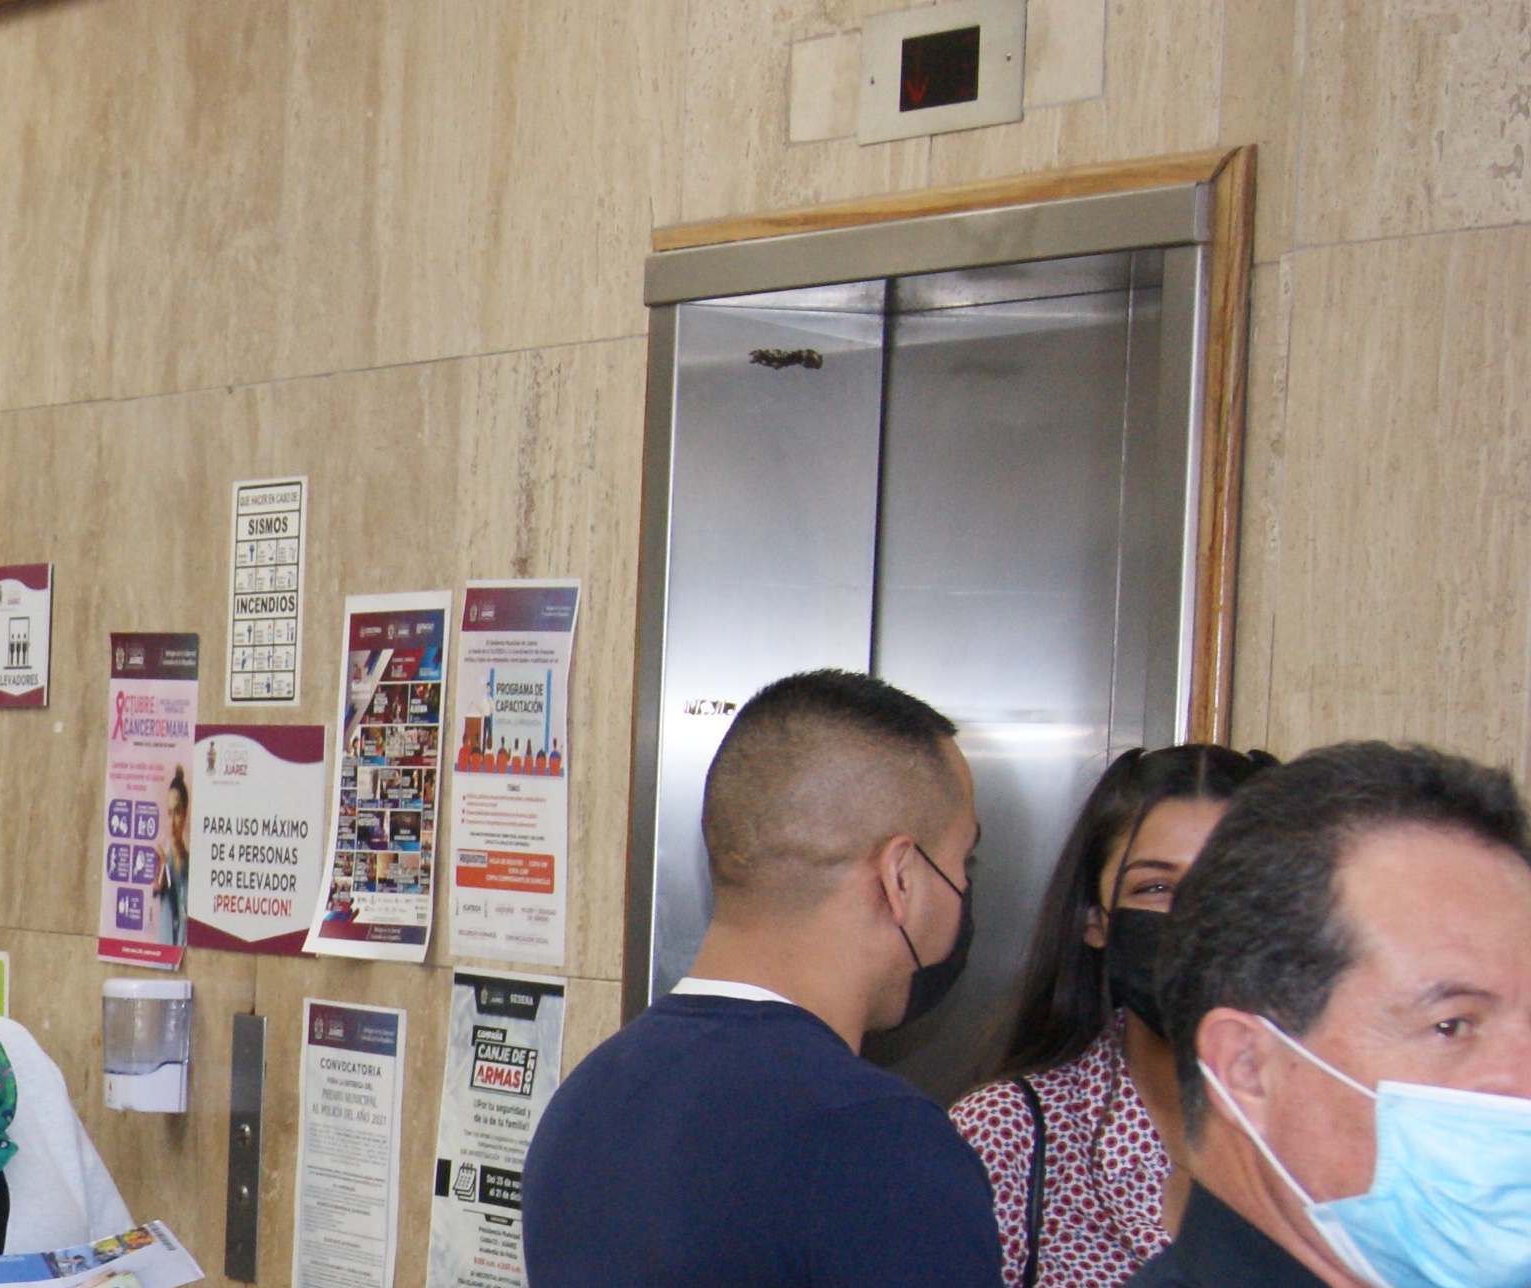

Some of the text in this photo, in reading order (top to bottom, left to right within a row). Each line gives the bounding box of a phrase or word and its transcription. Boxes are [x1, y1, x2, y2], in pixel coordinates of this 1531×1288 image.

[248, 516, 289, 536] SISMOS
[236, 595, 295, 615] INCENDIOS
[496, 682, 544, 696] PROGRAMA DE
[495, 697, 544, 713] CAPACITACIÓN
[203, 814, 309, 839] PARA USO MÁXIMO
[211, 843, 298, 866] DE 4 PERSONAS
[210, 869, 297, 892] POR ELEVADOR
[510, 993, 534, 1006] SEDENA
[477, 1043, 527, 1065] CANJE DE
[319, 1057, 382, 1078] CONVOCATORIA
[475, 1064, 523, 1089] ARMAS
[321, 1088, 377, 1108] PREMIO MUNICIPAL
[312, 1103, 320, 1115] AL
[343, 1107, 355, 1121] DEL
[355, 1108, 370, 1123] AÑO
[495, 1102, 526, 1116] seguridad
